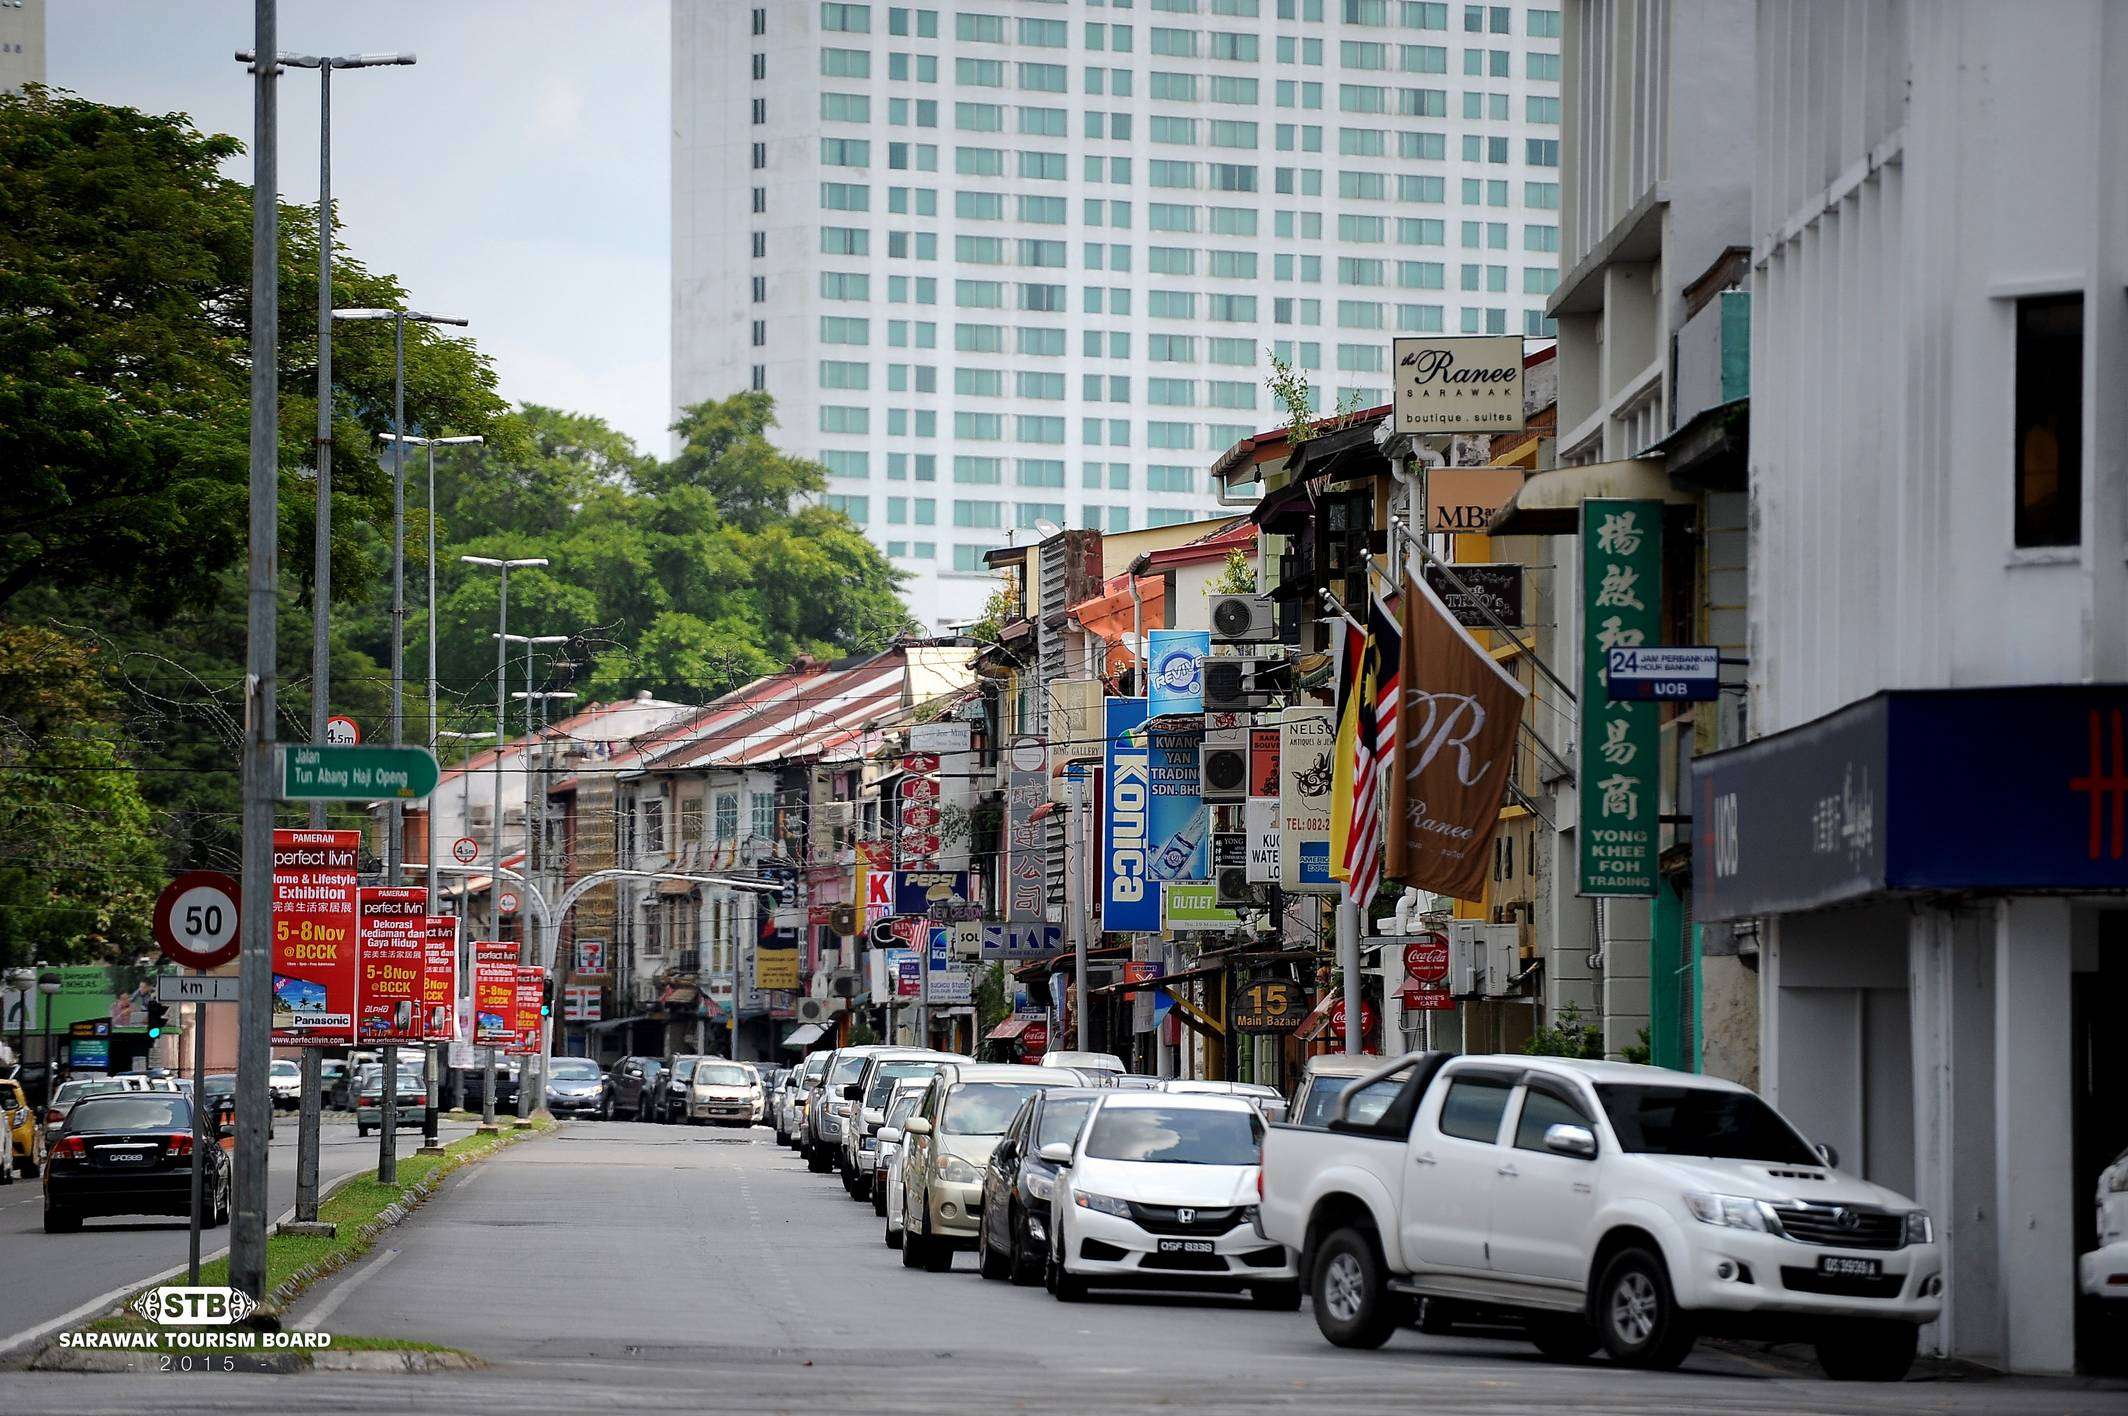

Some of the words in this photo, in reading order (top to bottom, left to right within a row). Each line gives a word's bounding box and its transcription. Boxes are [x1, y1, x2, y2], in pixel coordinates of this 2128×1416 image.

[1415, 350, 1516, 384] Ranee
[1407, 389, 1511, 397] SARAWAK
[1407, 412, 1462, 424] boutique
[1474, 413, 1512, 422] suites
[1613, 652, 1638, 673] 24
[1155, 654, 1202, 690] REVIVE
[1654, 682, 1688, 695] UOB
[295, 750, 320, 764] Jalan
[1071, 747, 1099, 755] GALLERY
[1167, 753, 1191, 764] YAN
[296, 768, 313, 784] Tun
[318, 768, 348, 787] Abang
[353, 768, 372, 787] Haji
[376, 769, 408, 788] Openg
[1152, 784, 1178, 795] SDN.
[1113, 755, 1147, 903] Konica
[1286, 818, 1305, 830] TEL:
[292, 834, 334, 844] PAMERAN
[1592, 830, 1648, 842] YONG
[1714, 792, 1739, 877] UOB
[1592, 845, 1646, 857] KHEE
[274, 850, 325, 866] perfect
[1600, 861, 1640, 872] FOH
[302, 874, 309, 885] &
[313, 874, 356, 887] Lifestyle
[905, 873, 958, 887] PEPSI
[1588, 876, 1650, 887] TRADING
[279, 886, 346, 900] Exhibition
[272, 902, 352, 913] 完美生活家居展
[1173, 895, 1213, 909] OUTLET
[364, 902, 401, 915] perfect
[185, 905, 222, 936] 50
[373, 920, 413, 929] Dekorasi
[361, 929, 405, 938] Kediaman
[407, 930, 425, 939] dan
[960, 933, 980, 942] SOL
[985, 926, 1062, 949] STAR
[367, 938, 389, 949] Gaya
[391, 938, 418, 949] Hidup
[1247, 985, 1289, 1016] 15
[294, 1015, 350, 1025] Panasonic
[1237, 1015, 1262, 1026] Main
[1266, 1015, 1301, 1026] Bazaar
